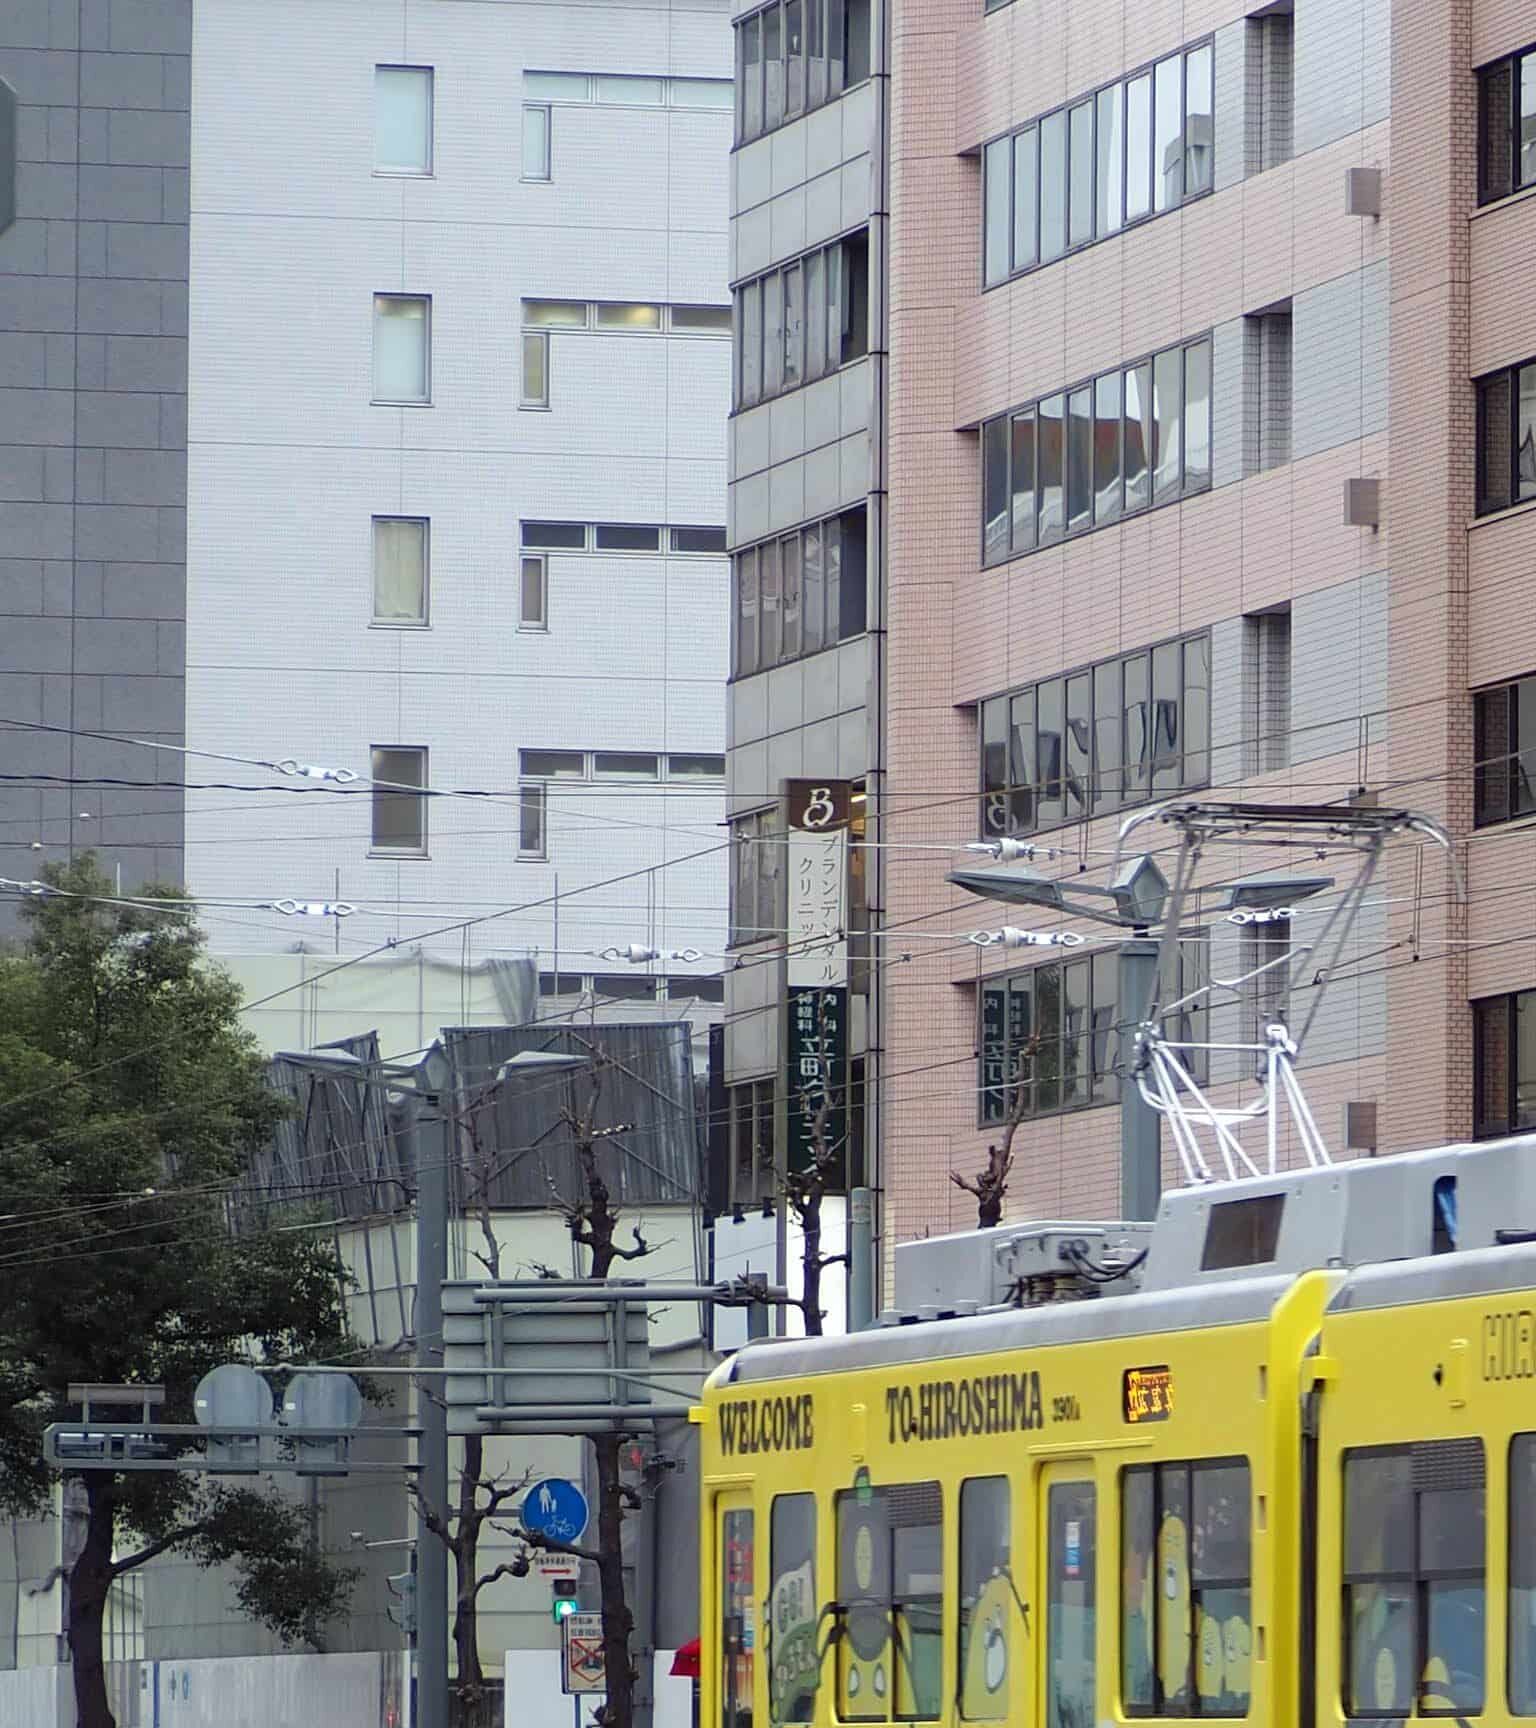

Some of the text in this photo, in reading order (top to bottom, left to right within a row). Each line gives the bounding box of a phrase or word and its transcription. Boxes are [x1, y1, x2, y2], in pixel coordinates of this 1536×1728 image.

[718, 1370, 1044, 1457] WELCOME TO HIROSHIMA
